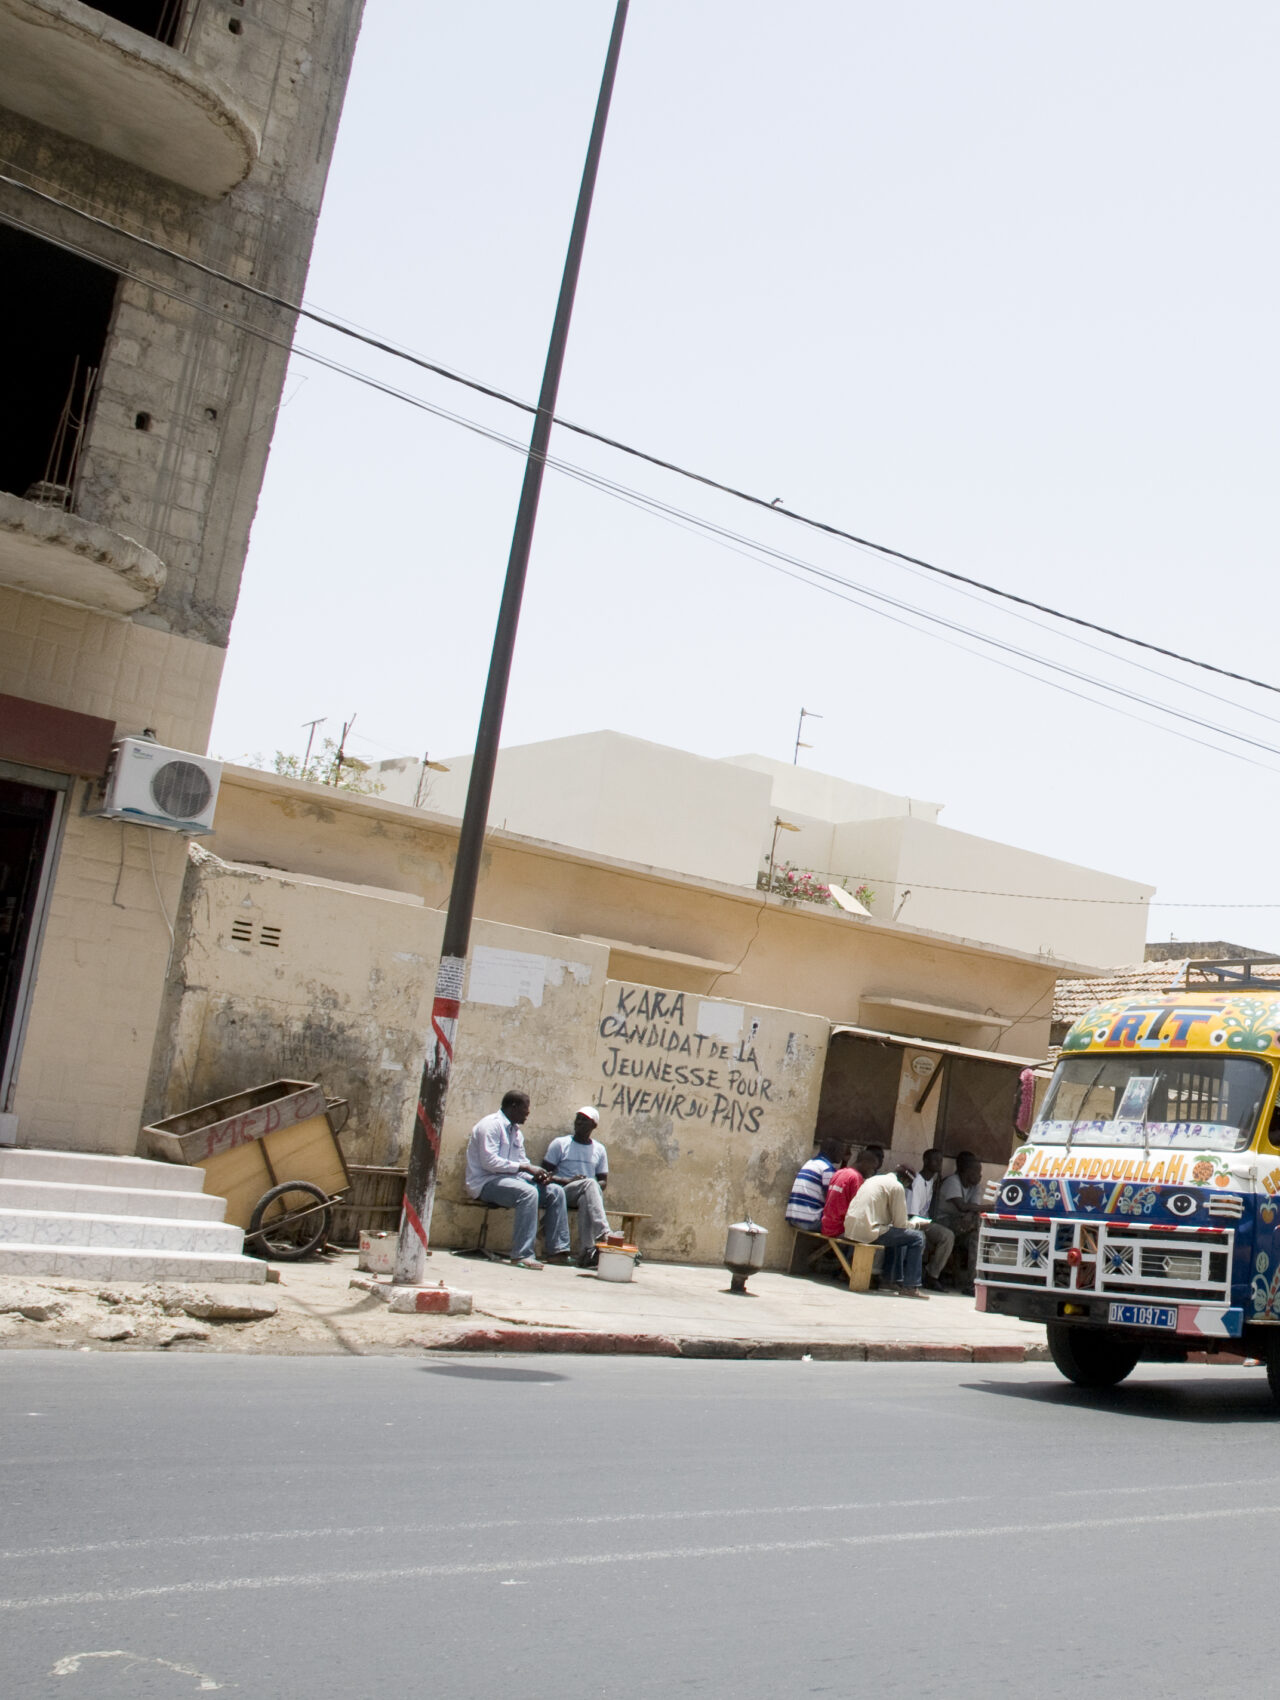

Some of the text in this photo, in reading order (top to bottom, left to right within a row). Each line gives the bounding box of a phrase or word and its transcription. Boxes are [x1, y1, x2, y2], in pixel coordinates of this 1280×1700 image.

[617, 987, 685, 1025] KARA
[600, 1016, 759, 1072] CANDIDAT DE LA
[602, 1047, 774, 1101] JEUNESSE POUR
[595, 1082, 764, 1133] L'AVENIR DU PAYS
